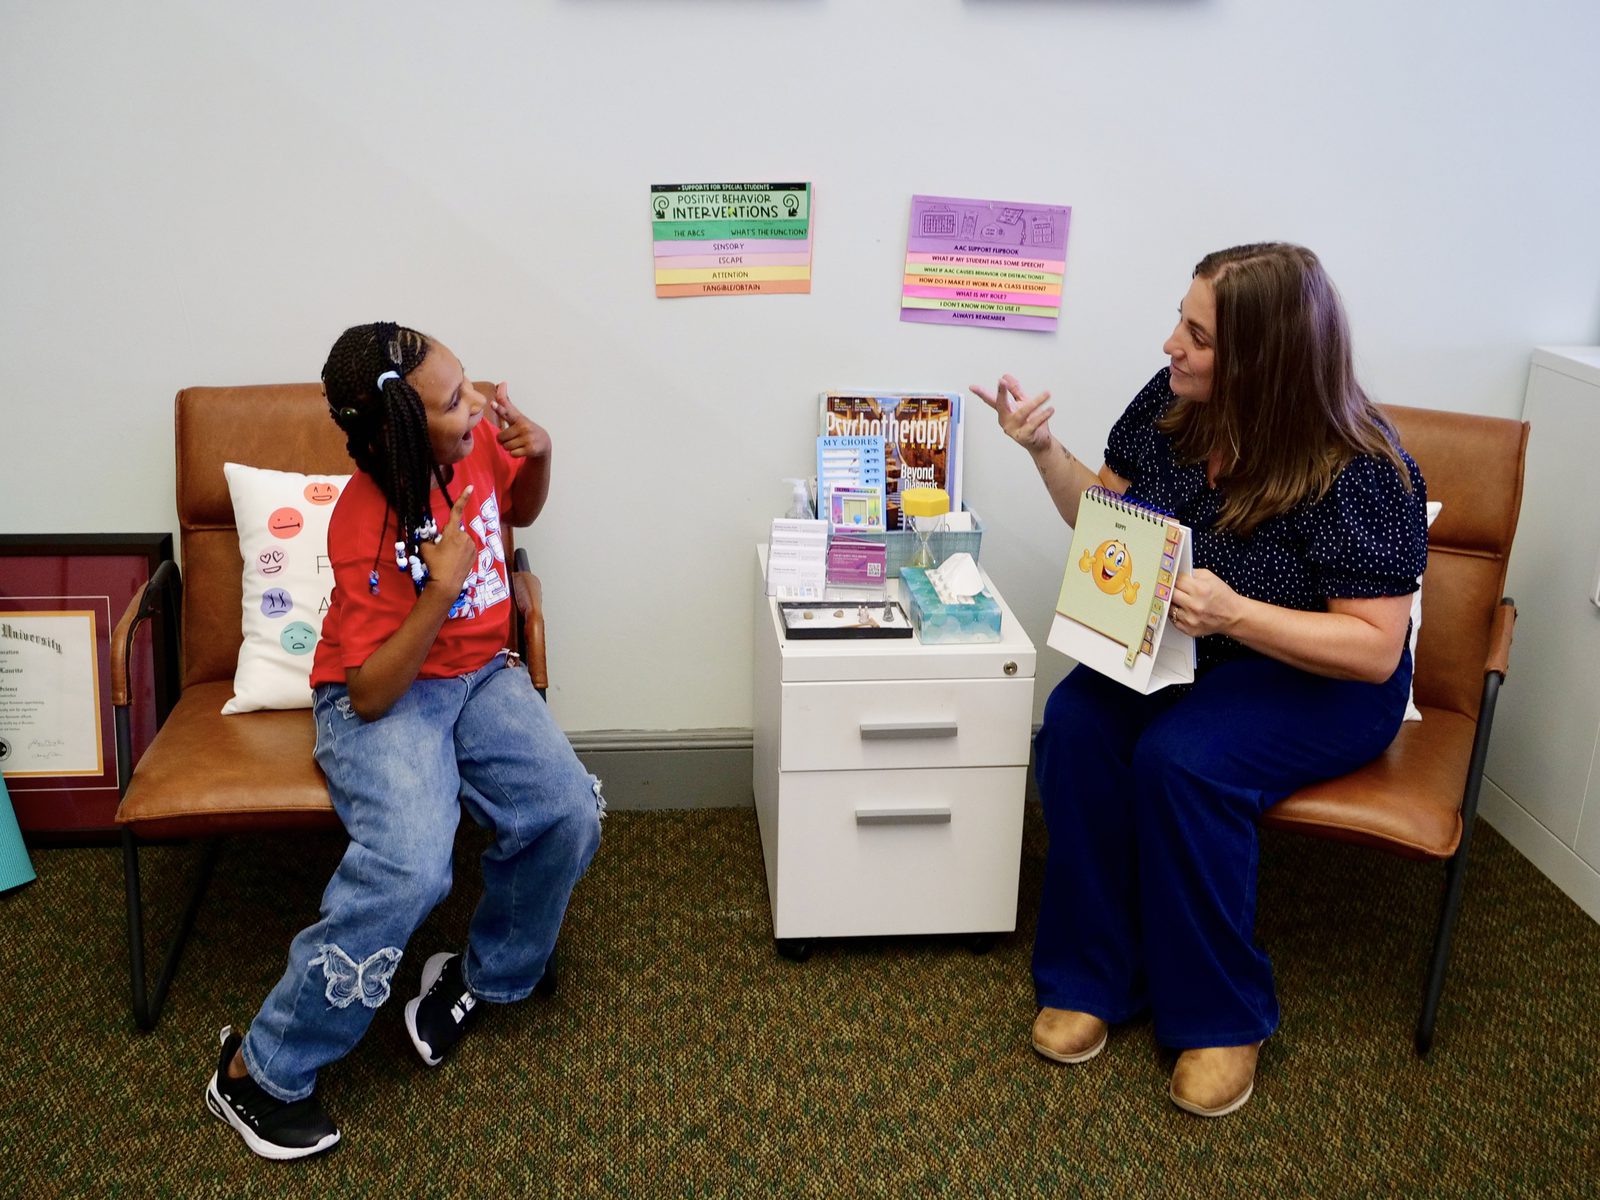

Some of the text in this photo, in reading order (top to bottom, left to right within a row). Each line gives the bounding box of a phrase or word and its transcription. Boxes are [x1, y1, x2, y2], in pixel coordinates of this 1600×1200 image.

[677, 194, 771, 204] POSITIVE BEHAVIOR
[673, 205, 778, 219] INTERVENTIONS
[731, 228, 808, 236] WHAT'S THE FUNCTION?
[713, 243, 744, 251] SENSORY
[992, 247, 1019, 255] FLIPBOOK
[718, 256, 743, 264] ESCAPE
[1021, 261, 1045, 269] SPEECH?
[712, 271, 749, 279] ATTENTION
[1008, 272, 1045, 280] DISTRACTIONS?
[703, 284, 761, 292] TANGIBLE/OBTAIN
[975, 314, 1006, 322] REMEMBER
[826, 412, 948, 450] Psychotherapy
[841, 438, 878, 446] CHORES
[901, 463, 935, 481] Beyond
[904, 479, 939, 490] Diagnosis
[1, 623, 62, 654] University
